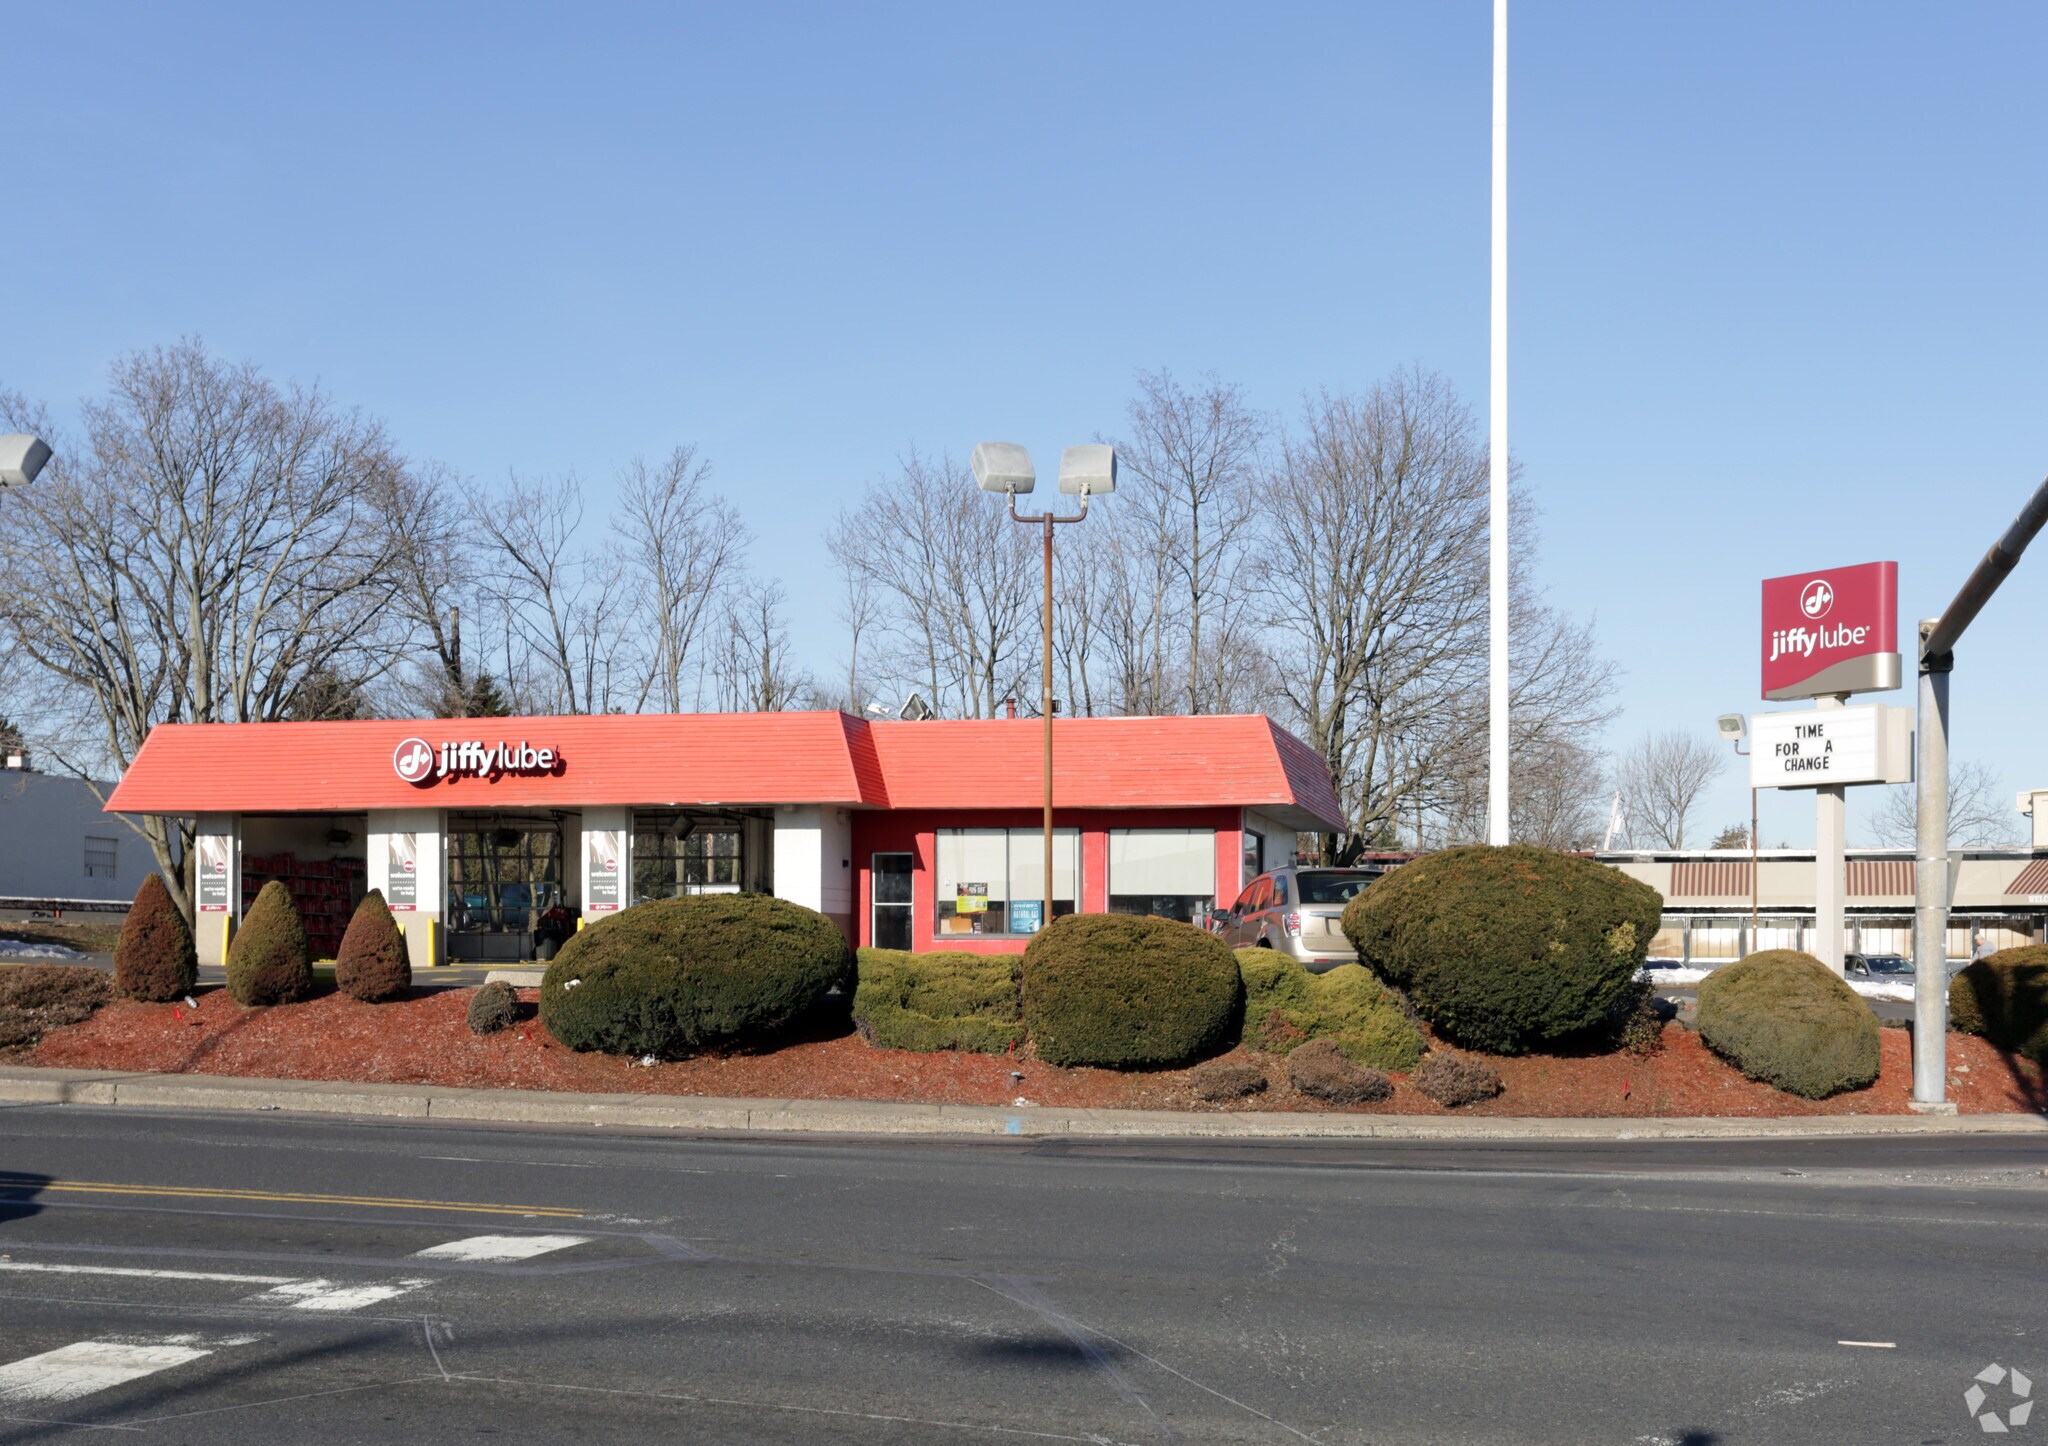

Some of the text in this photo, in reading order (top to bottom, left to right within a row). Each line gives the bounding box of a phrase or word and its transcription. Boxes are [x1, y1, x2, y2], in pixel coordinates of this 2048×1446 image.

[1794, 723, 1824, 739] TIME
[1775, 739, 1833, 757] FOR A
[1784, 755, 1830, 772] CHANGE
[201, 872, 226, 880] welcome
[389, 871, 415, 879] welcome
[590, 870, 617, 878] welcome
